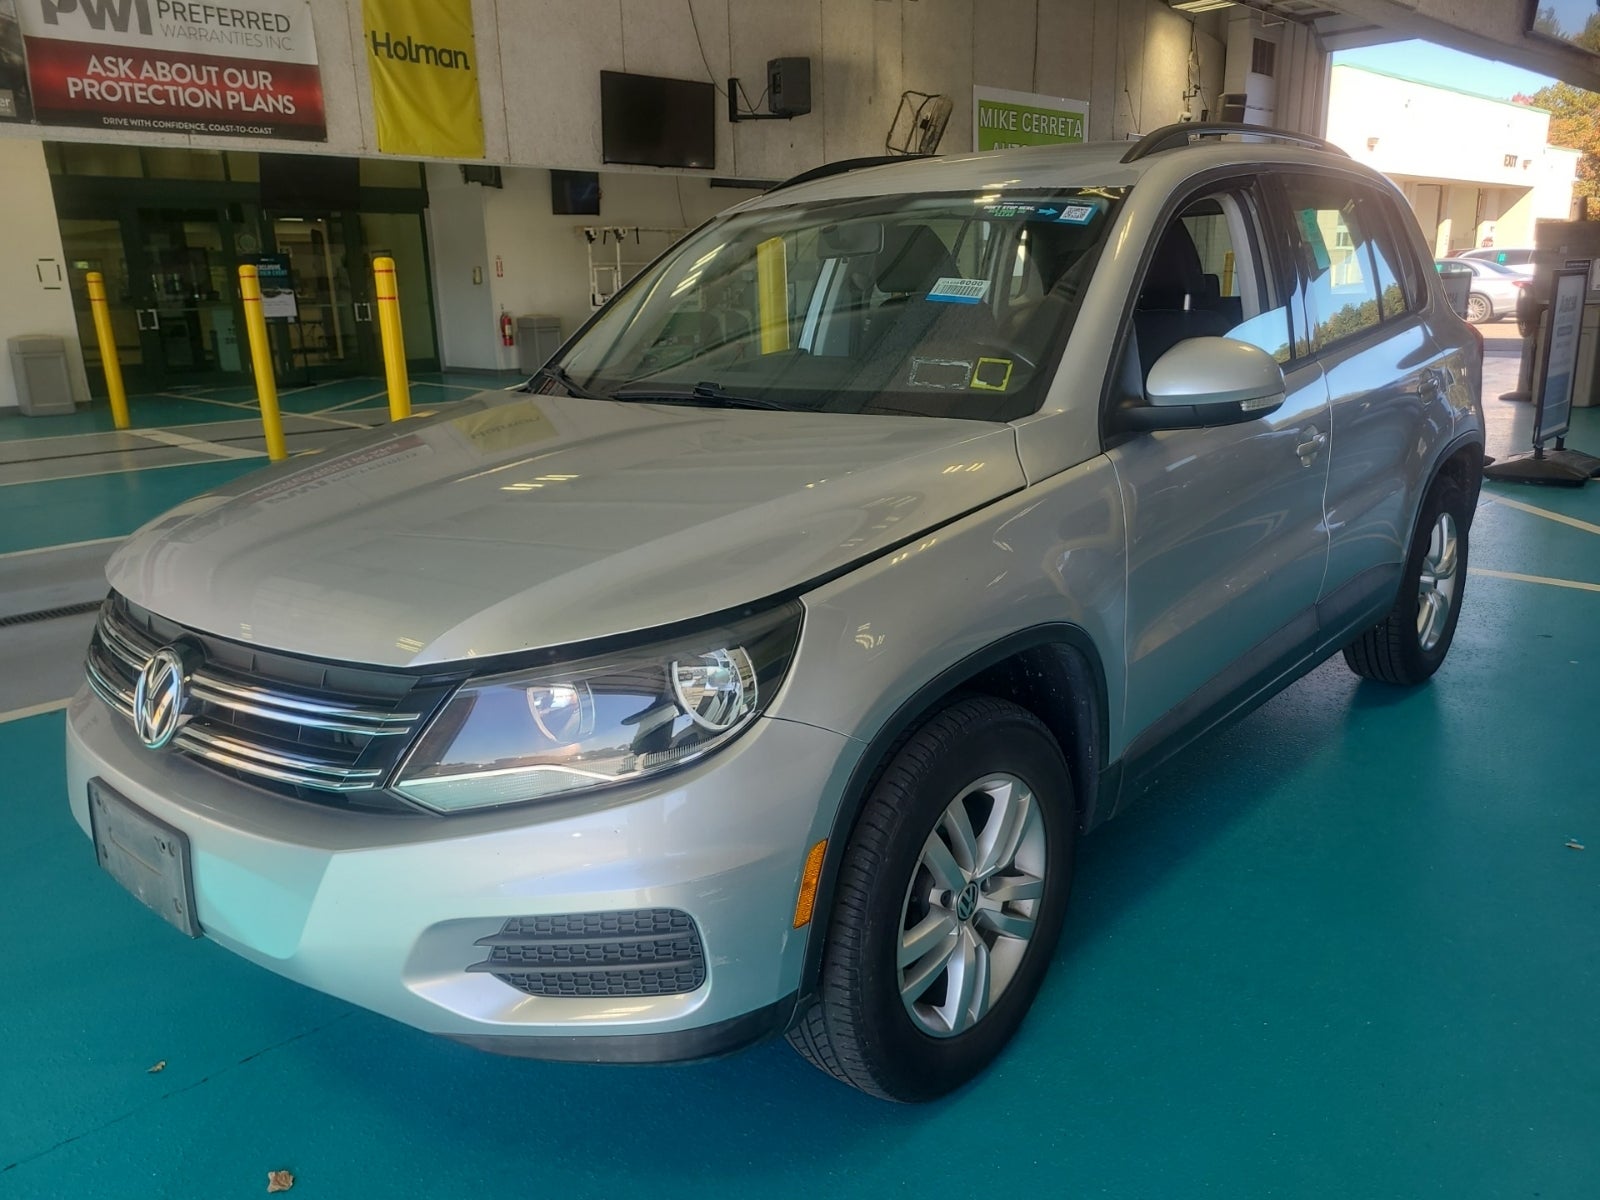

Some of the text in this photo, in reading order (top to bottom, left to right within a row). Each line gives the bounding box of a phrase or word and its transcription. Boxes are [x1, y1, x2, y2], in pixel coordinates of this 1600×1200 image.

[40, 0, 153, 35] PWI
[157, 0, 291, 33] PREFERRED
[160, 23, 296, 51] WARRANTIES INC.
[371, 30, 471, 71] Holman
[86, 54, 273, 91] ASK ABOUT OUR
[67, 77, 296, 115] PROTECTION PLANS
[102, 117, 273, 135] DRIVE WITH CONFIDENCE, COAST-TO-COAST
[980, 107, 1083, 138] MIKE CERRETA
[1503, 154, 1518, 168] EXIT
